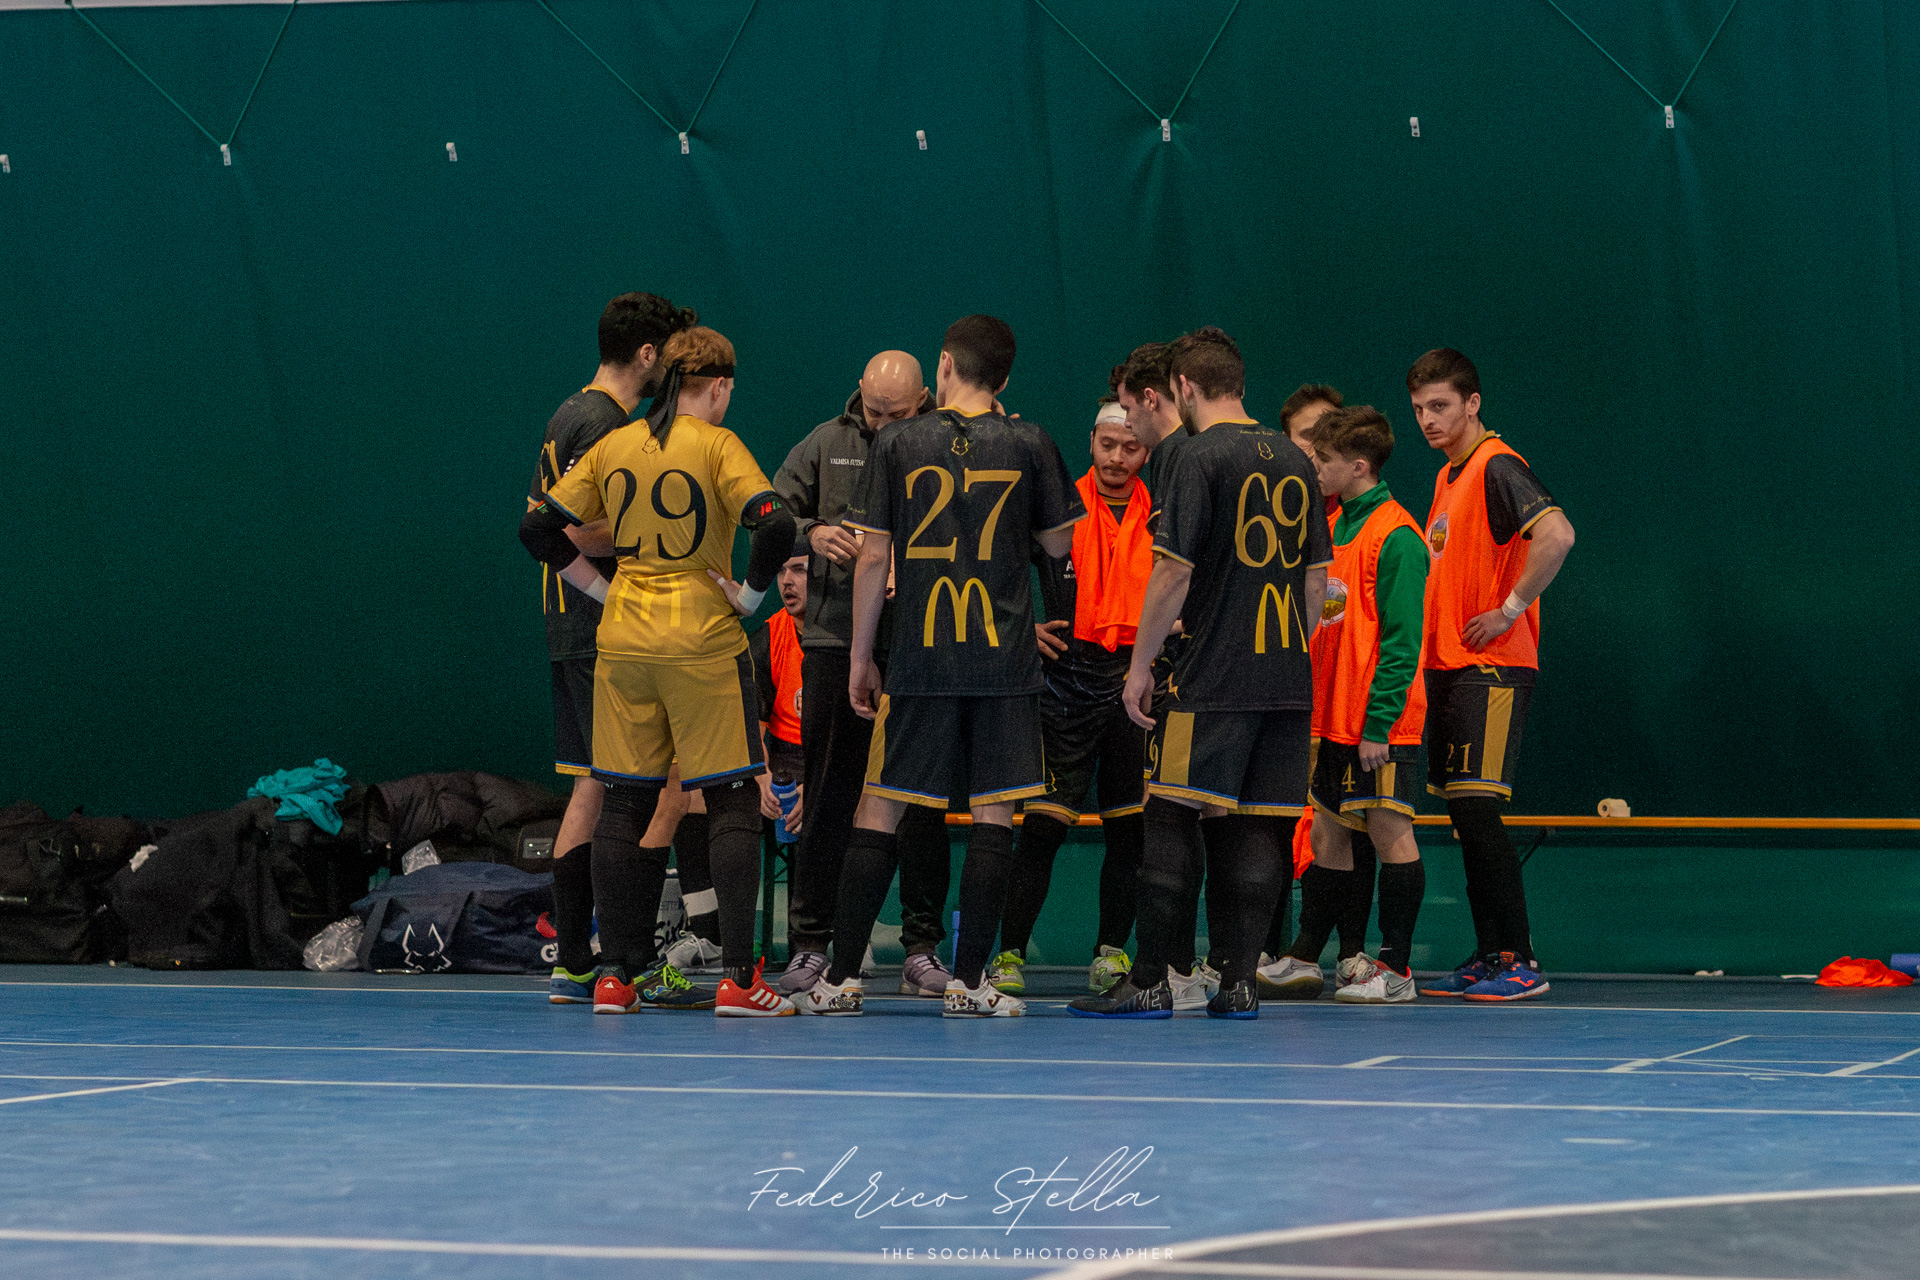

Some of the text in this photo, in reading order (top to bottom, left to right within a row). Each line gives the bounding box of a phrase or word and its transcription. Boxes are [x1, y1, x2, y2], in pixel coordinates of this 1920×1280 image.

[604, 467, 707, 560] 29
[905, 465, 1022, 563] 27
[1235, 472, 1310, 569] 69
[731, 780, 744, 789] 29
[1341, 762, 1356, 793] 4
[1446, 742, 1472, 773] 21
